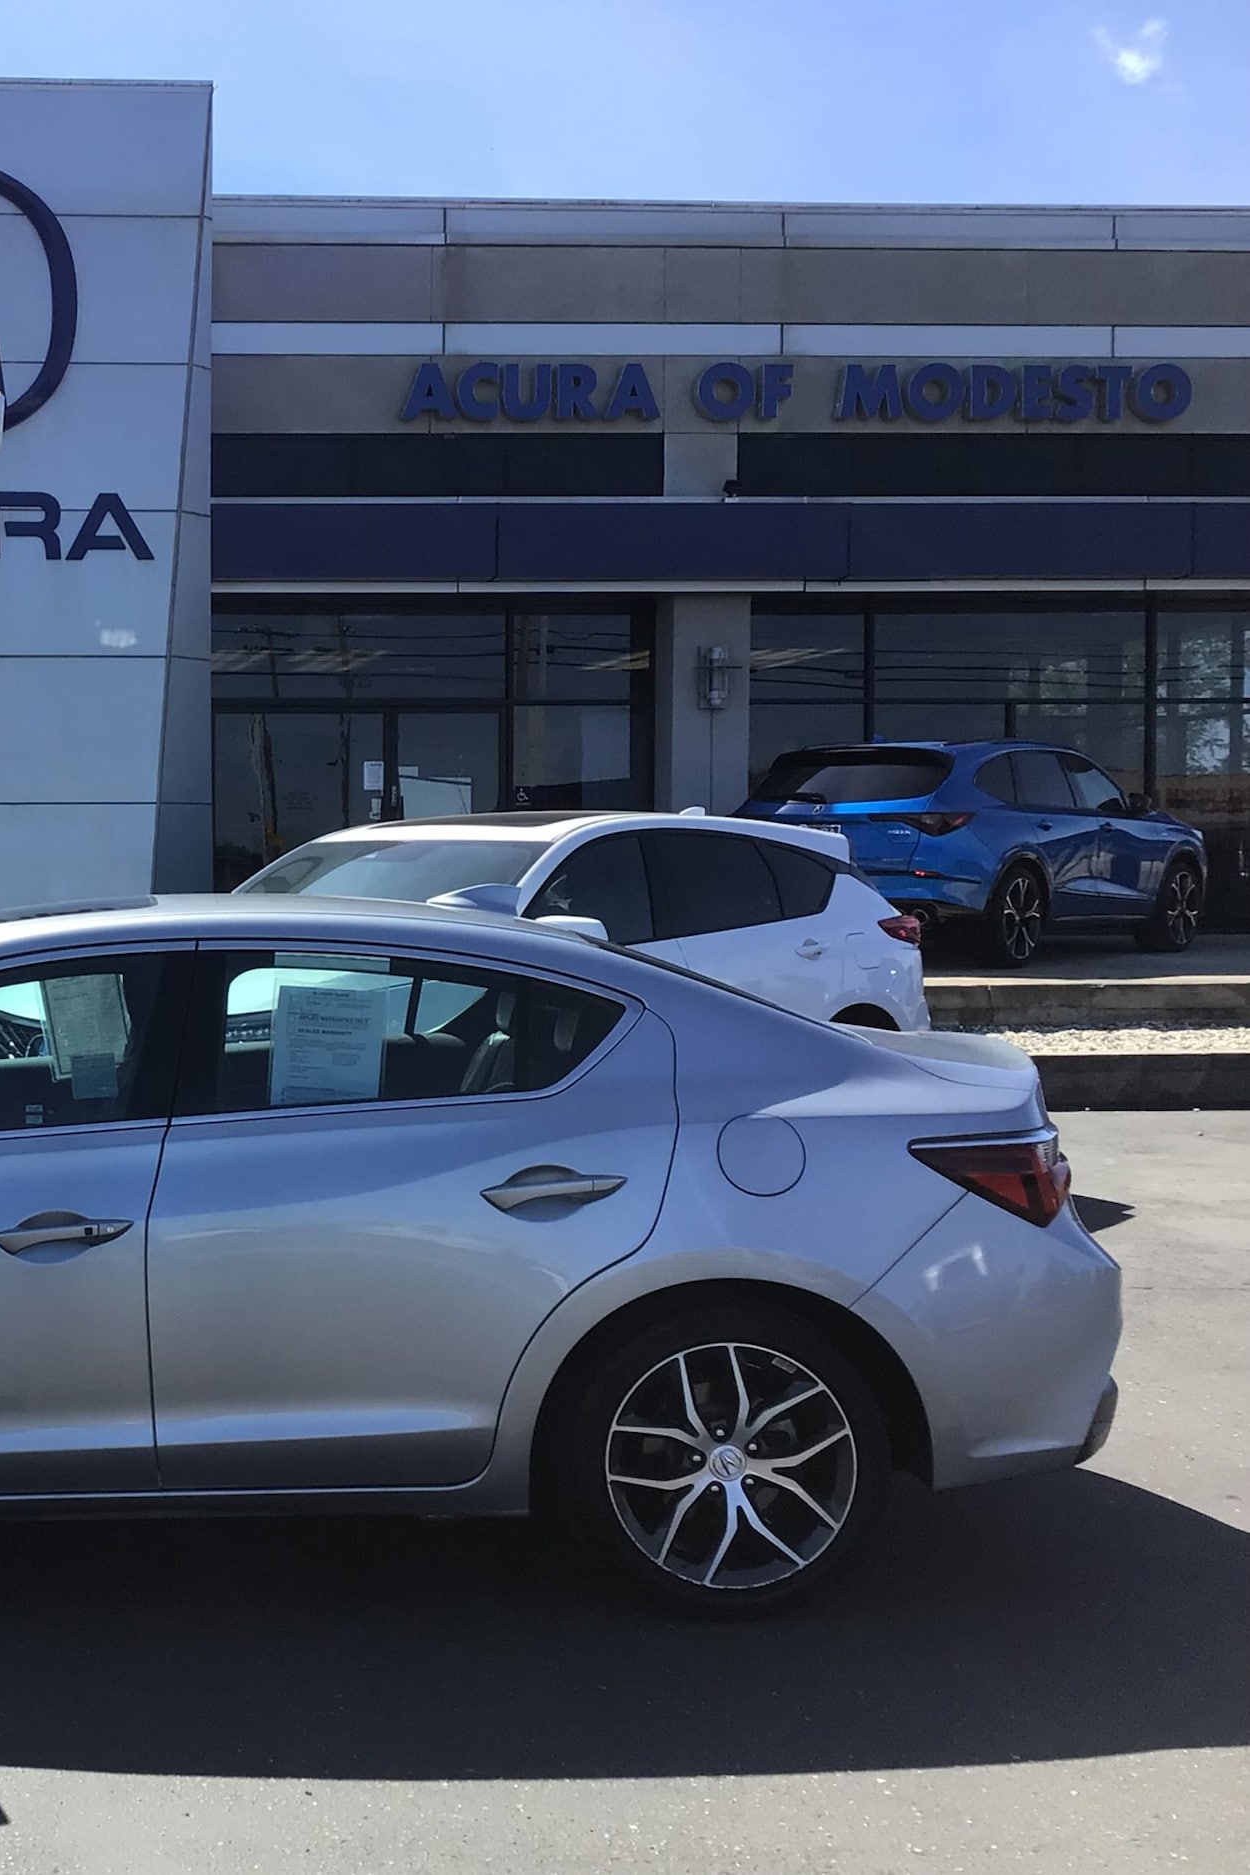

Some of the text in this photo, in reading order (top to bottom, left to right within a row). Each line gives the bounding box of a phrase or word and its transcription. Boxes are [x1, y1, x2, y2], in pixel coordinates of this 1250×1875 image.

[401, 361, 1193, 423] ACURA OF MODESTO
